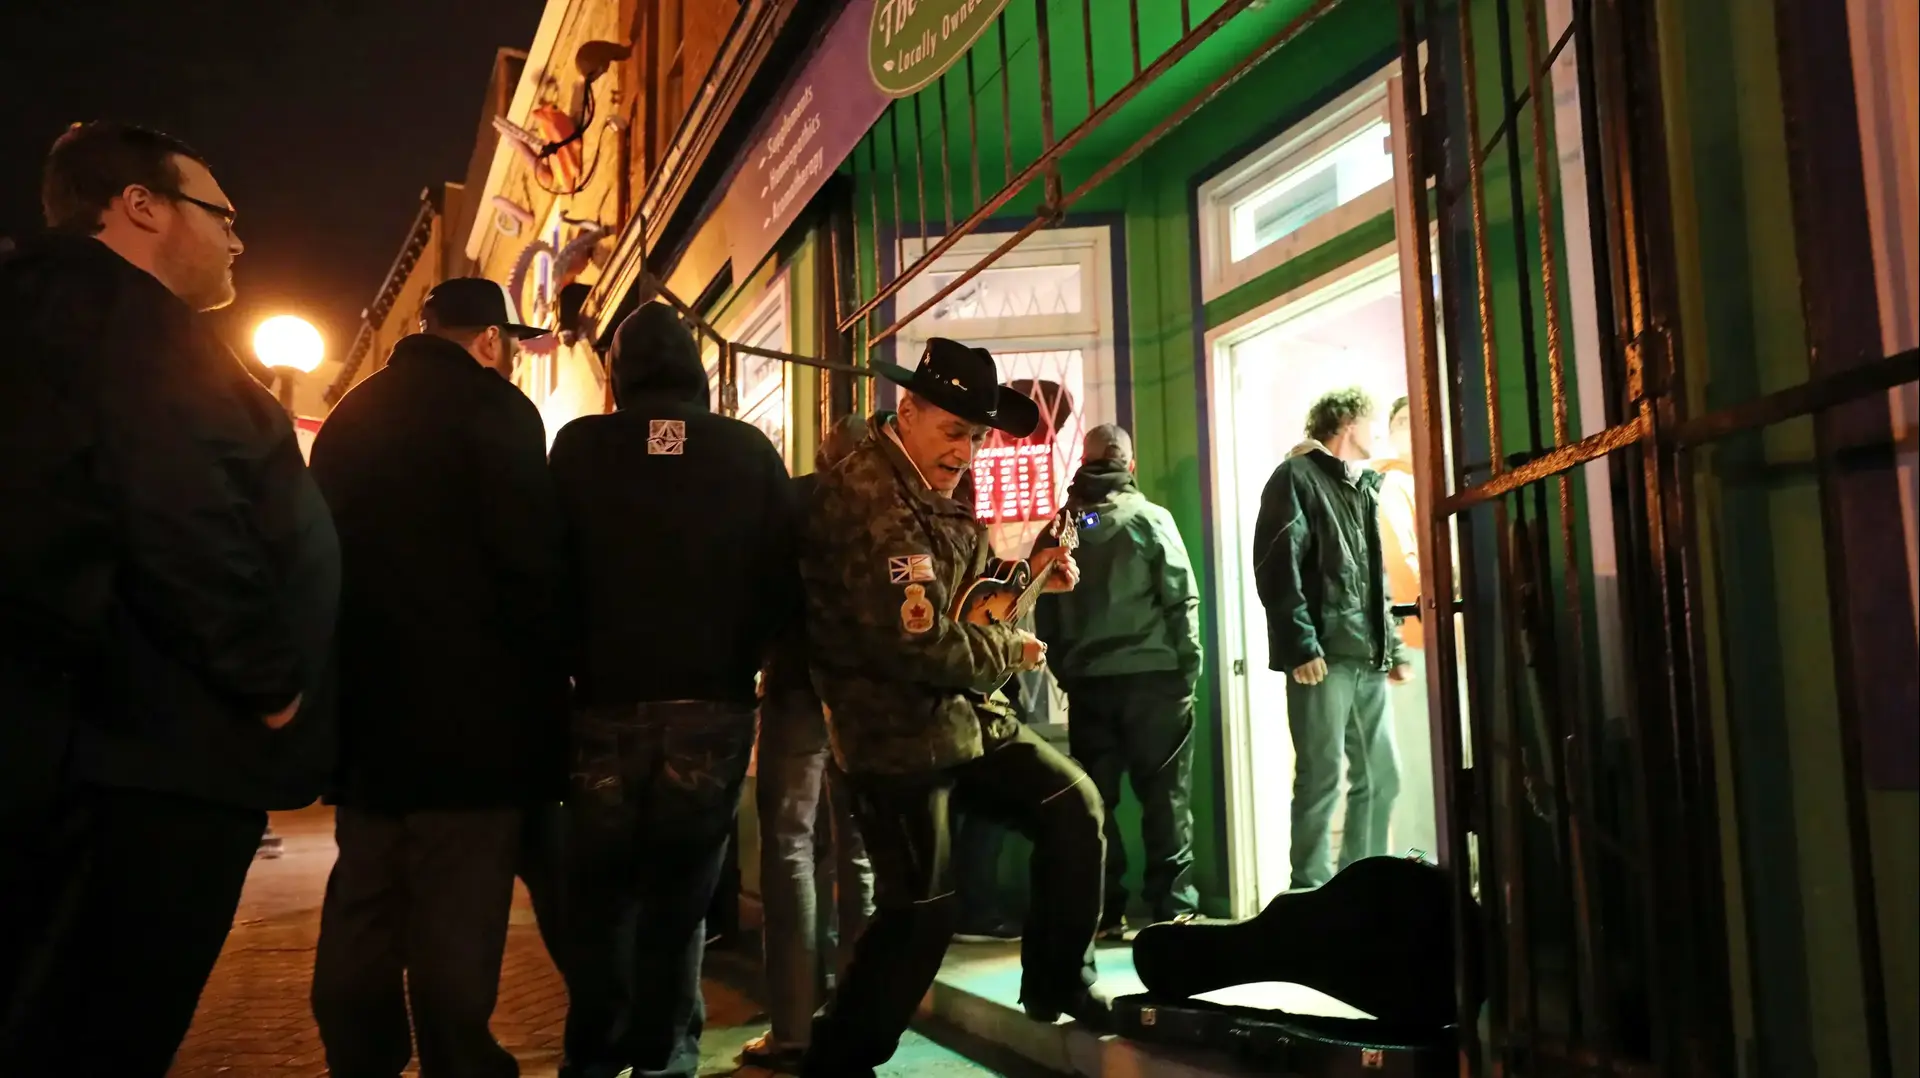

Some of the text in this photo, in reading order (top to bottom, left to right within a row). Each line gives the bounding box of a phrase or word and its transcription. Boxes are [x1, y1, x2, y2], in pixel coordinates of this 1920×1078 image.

[898, 0, 982, 74] Locally Owne
[767, 85, 813, 159] Supplements
[772, 146, 823, 222] Aromatherapy
